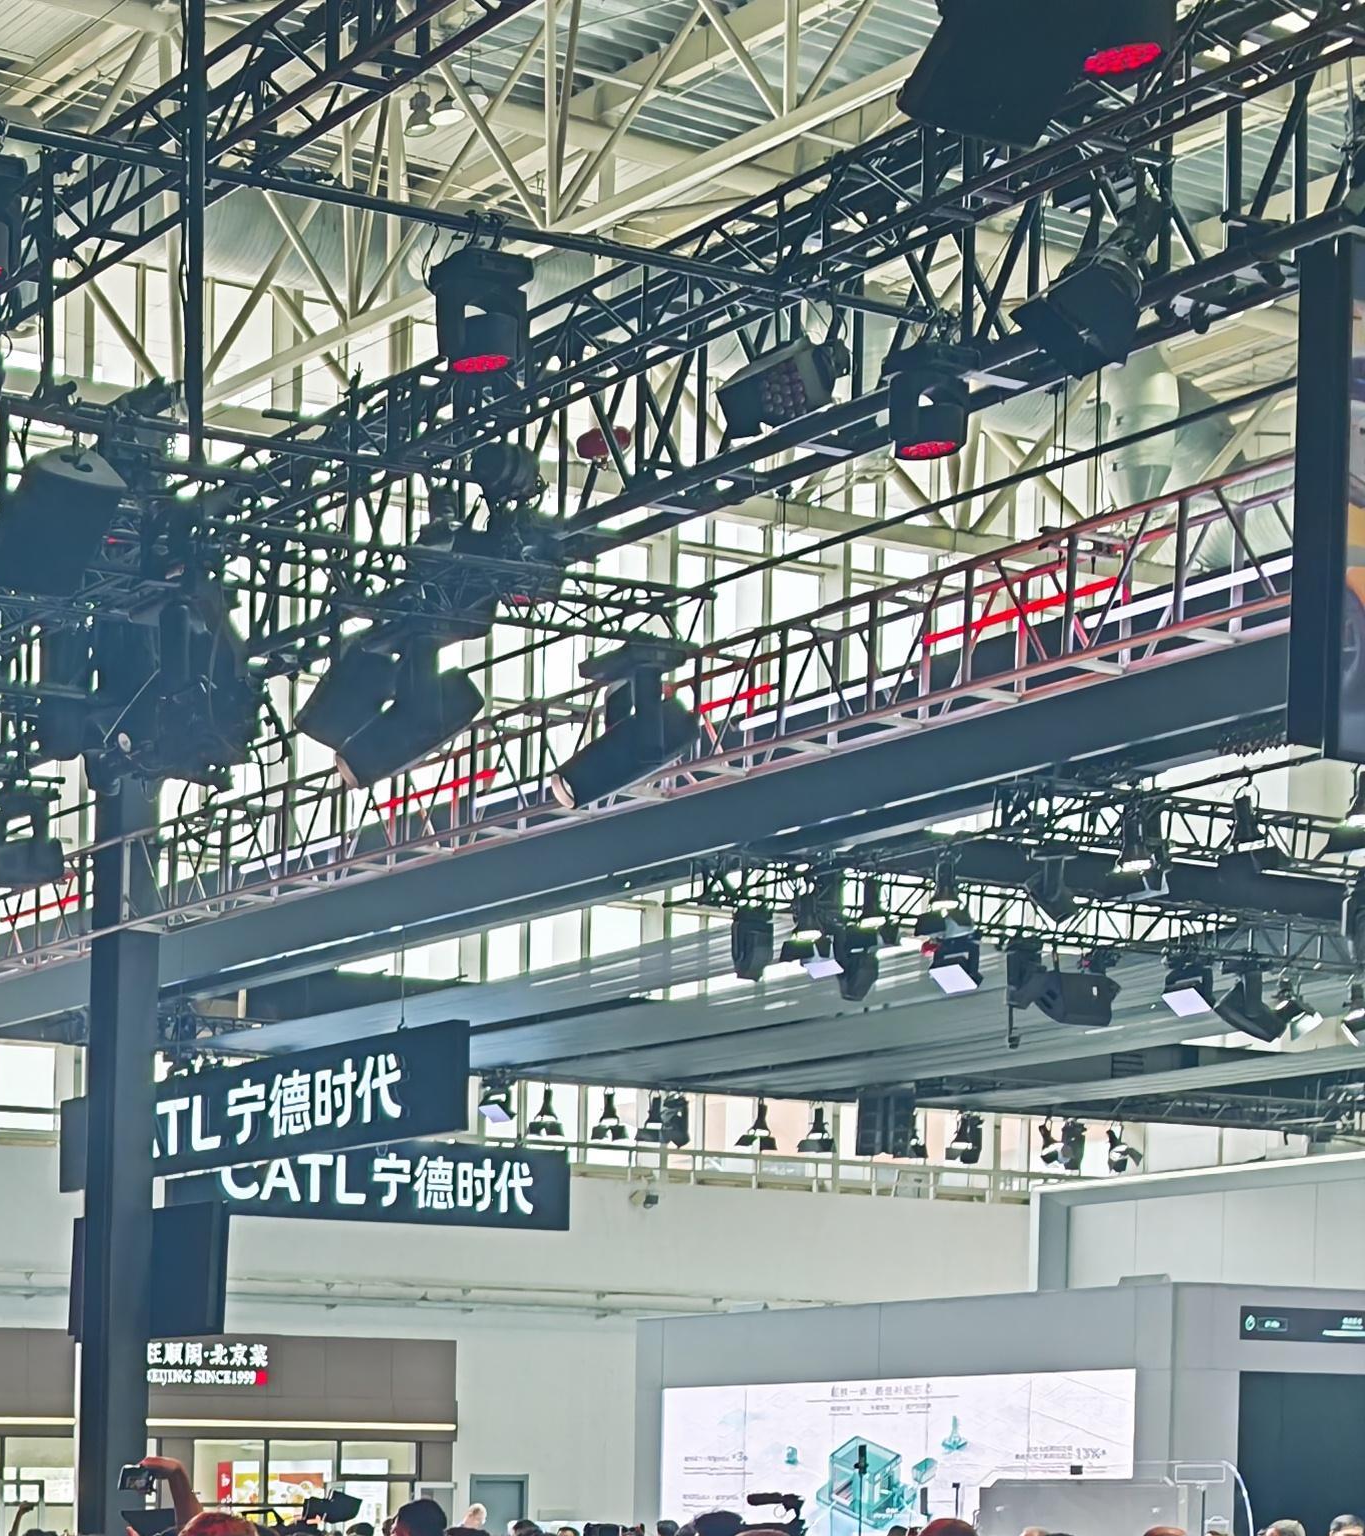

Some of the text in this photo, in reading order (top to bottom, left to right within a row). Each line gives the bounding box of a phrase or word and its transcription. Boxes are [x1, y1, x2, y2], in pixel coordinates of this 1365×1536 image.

[152, 1052, 402, 1158] TL 宁德时代
[220, 1153, 534, 1215] CATL 宁德时代
